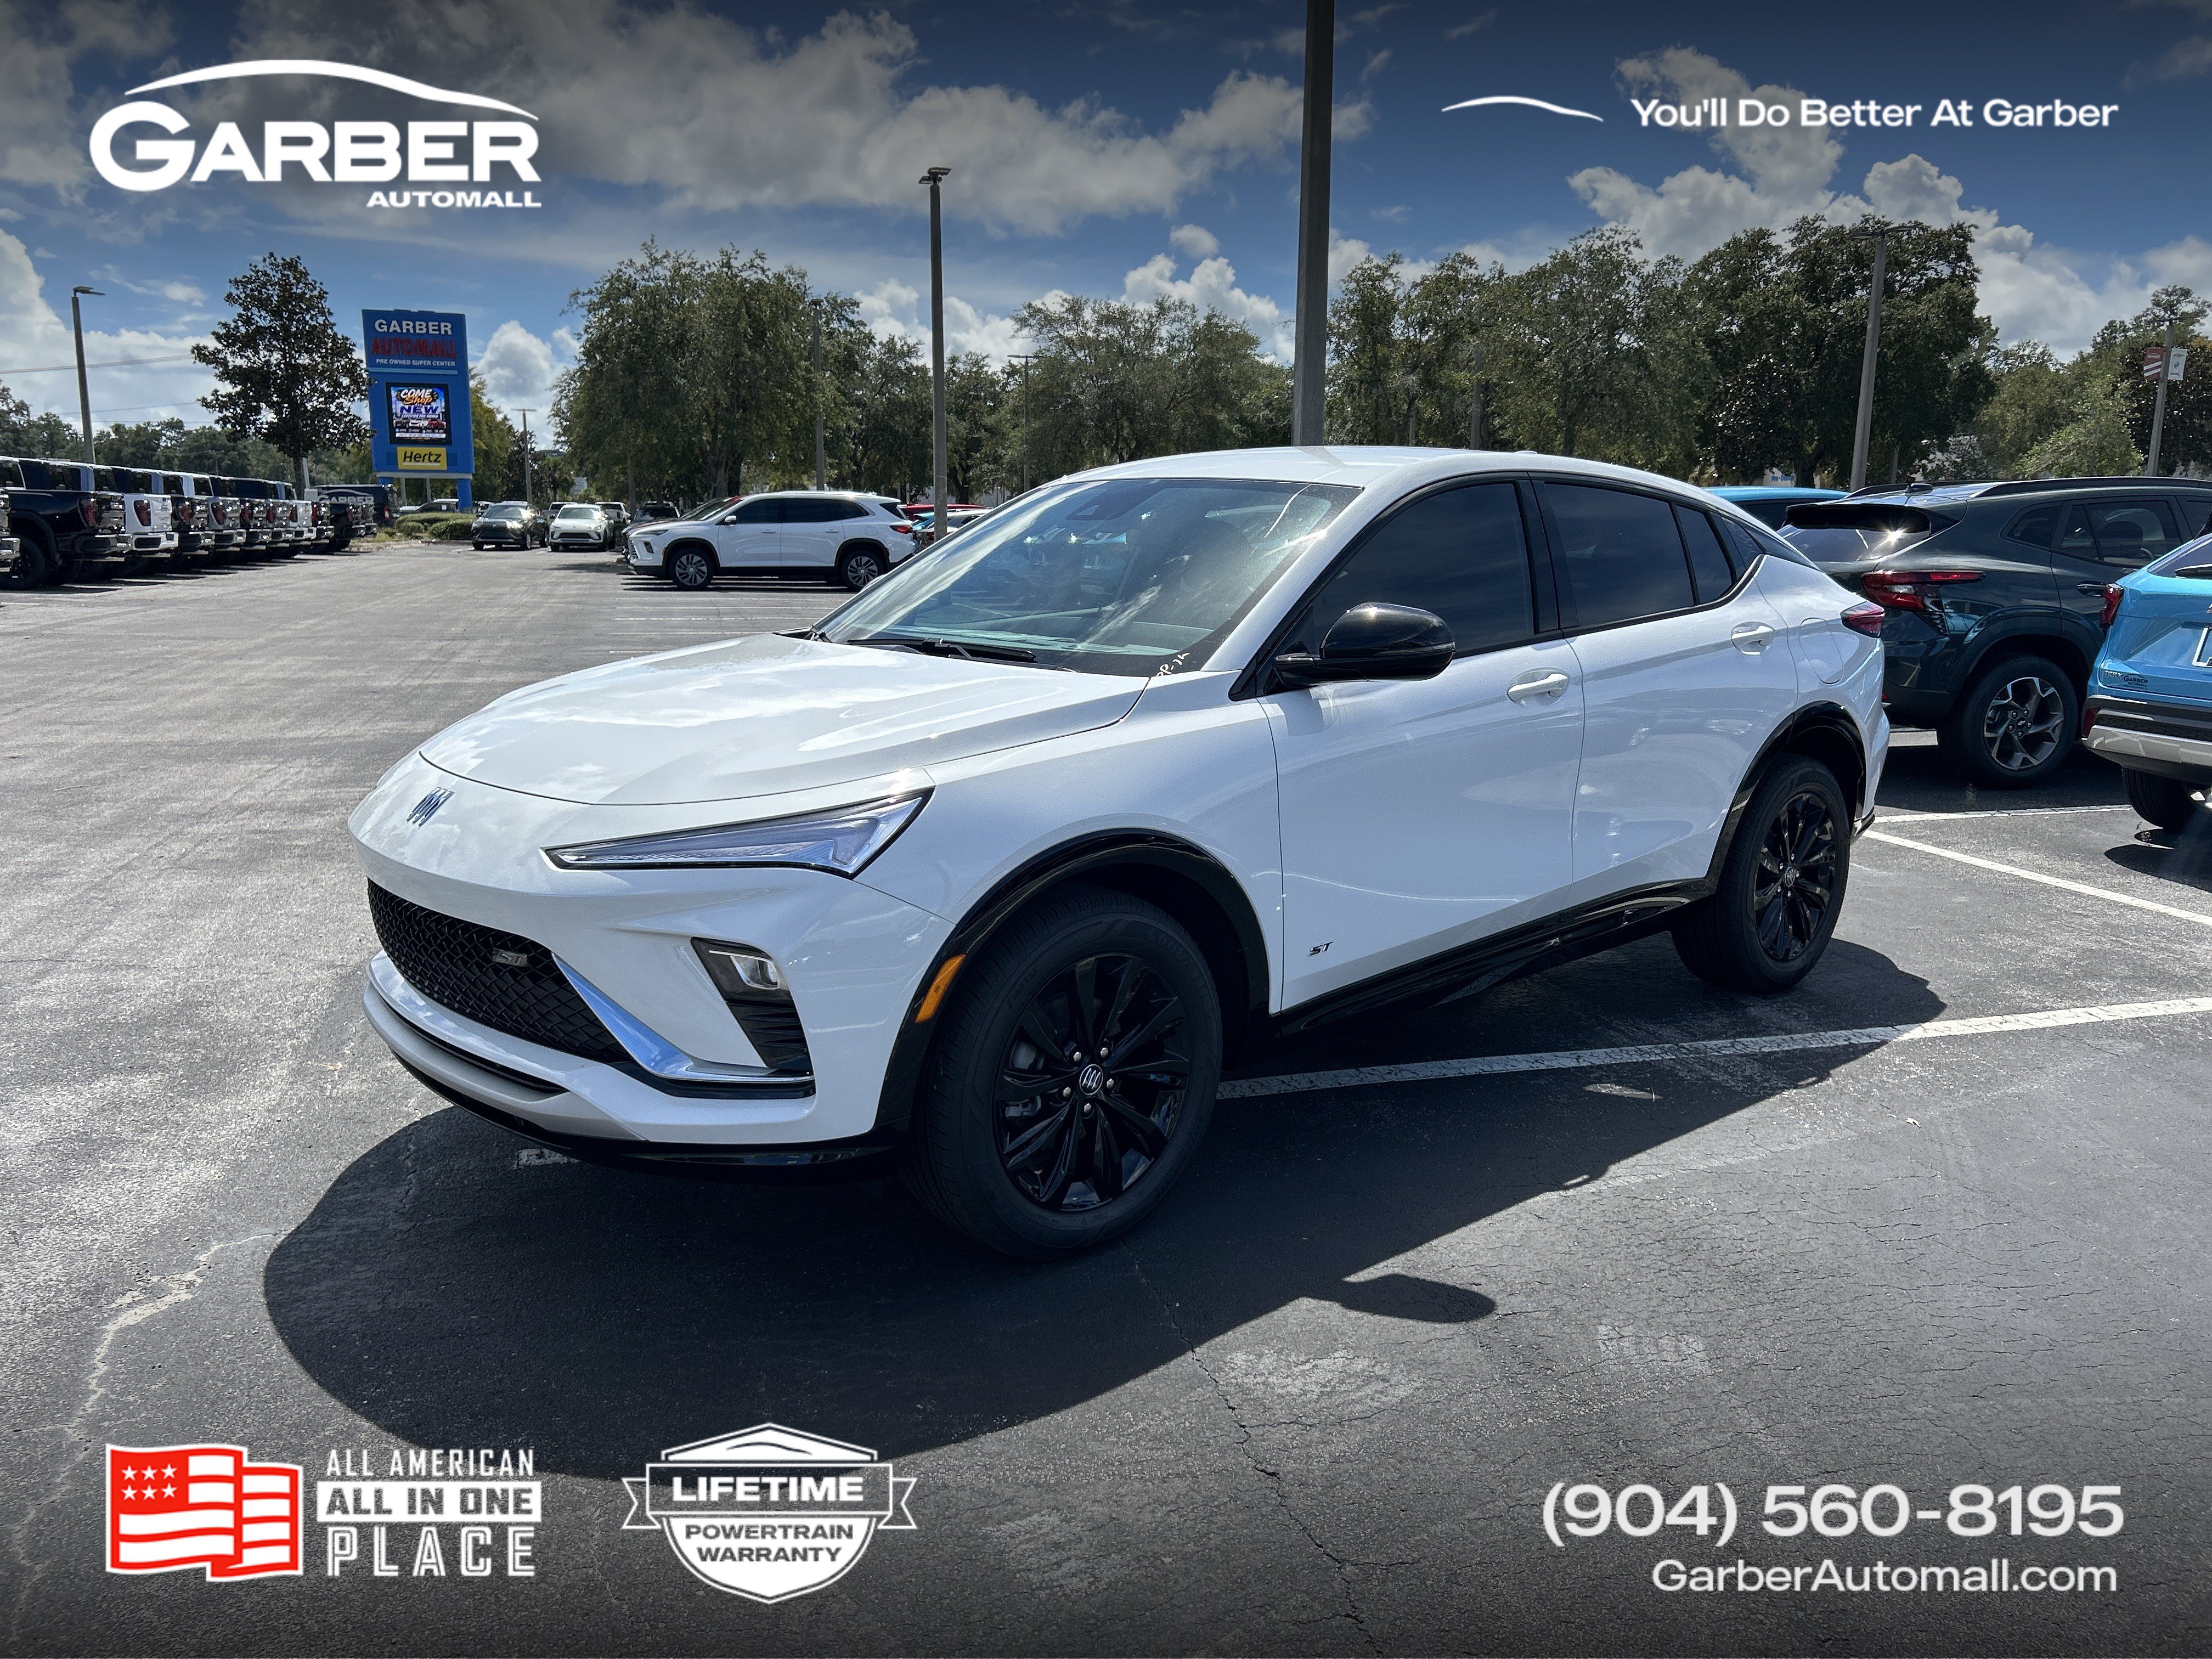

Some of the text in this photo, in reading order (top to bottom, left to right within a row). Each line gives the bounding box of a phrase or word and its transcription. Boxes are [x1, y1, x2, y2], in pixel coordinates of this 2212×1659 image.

[375, 319, 452, 335] GARBER
[372, 337, 458, 358] AUTOMALL
[400, 388, 433, 398] COME
[403, 451, 442, 463] Hertz
[2124, 675, 2148, 684] GARBER
[1308, 940, 1334, 957] ST
